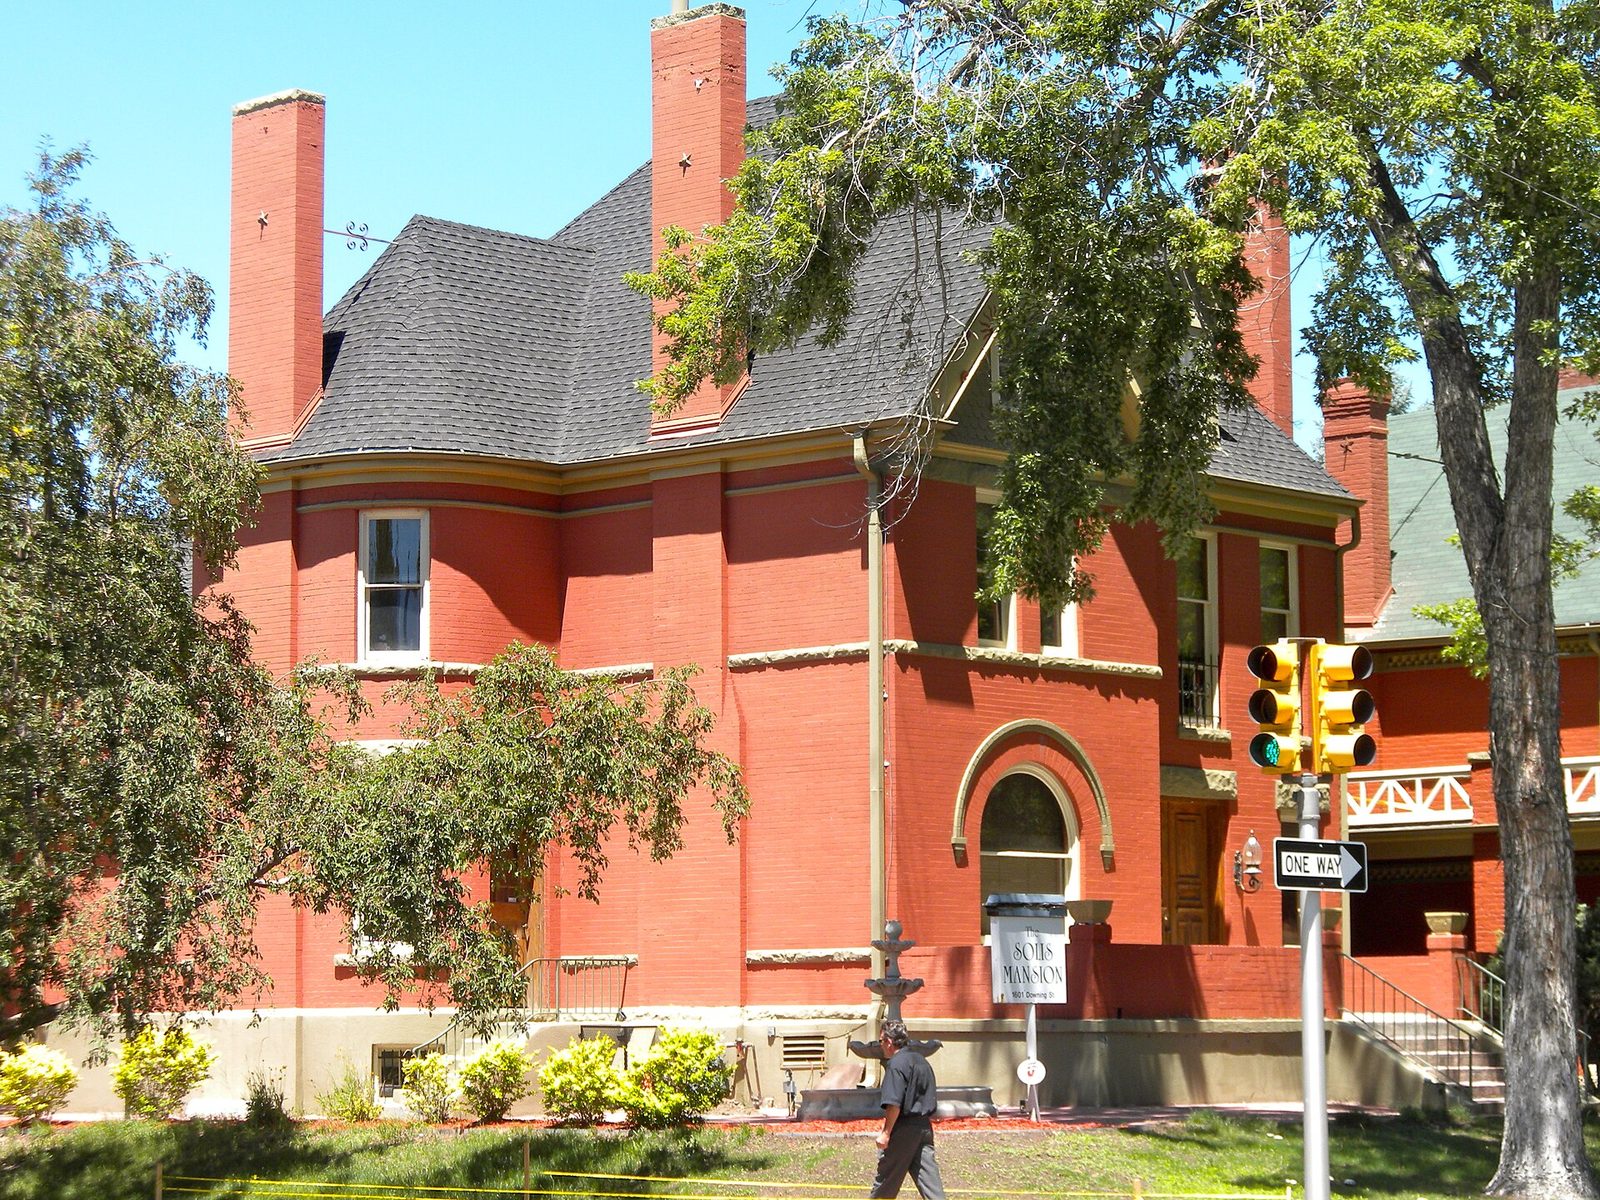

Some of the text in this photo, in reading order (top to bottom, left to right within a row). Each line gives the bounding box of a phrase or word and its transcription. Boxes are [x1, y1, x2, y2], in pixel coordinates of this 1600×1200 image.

[1286, 855, 1341, 874] ONE WAY
[1025, 926, 1040, 938] The
[1013, 942, 1053, 961] SOLIS
[1003, 965, 1063, 984] MANSION
[1026, 991, 1047, 999] Downing
